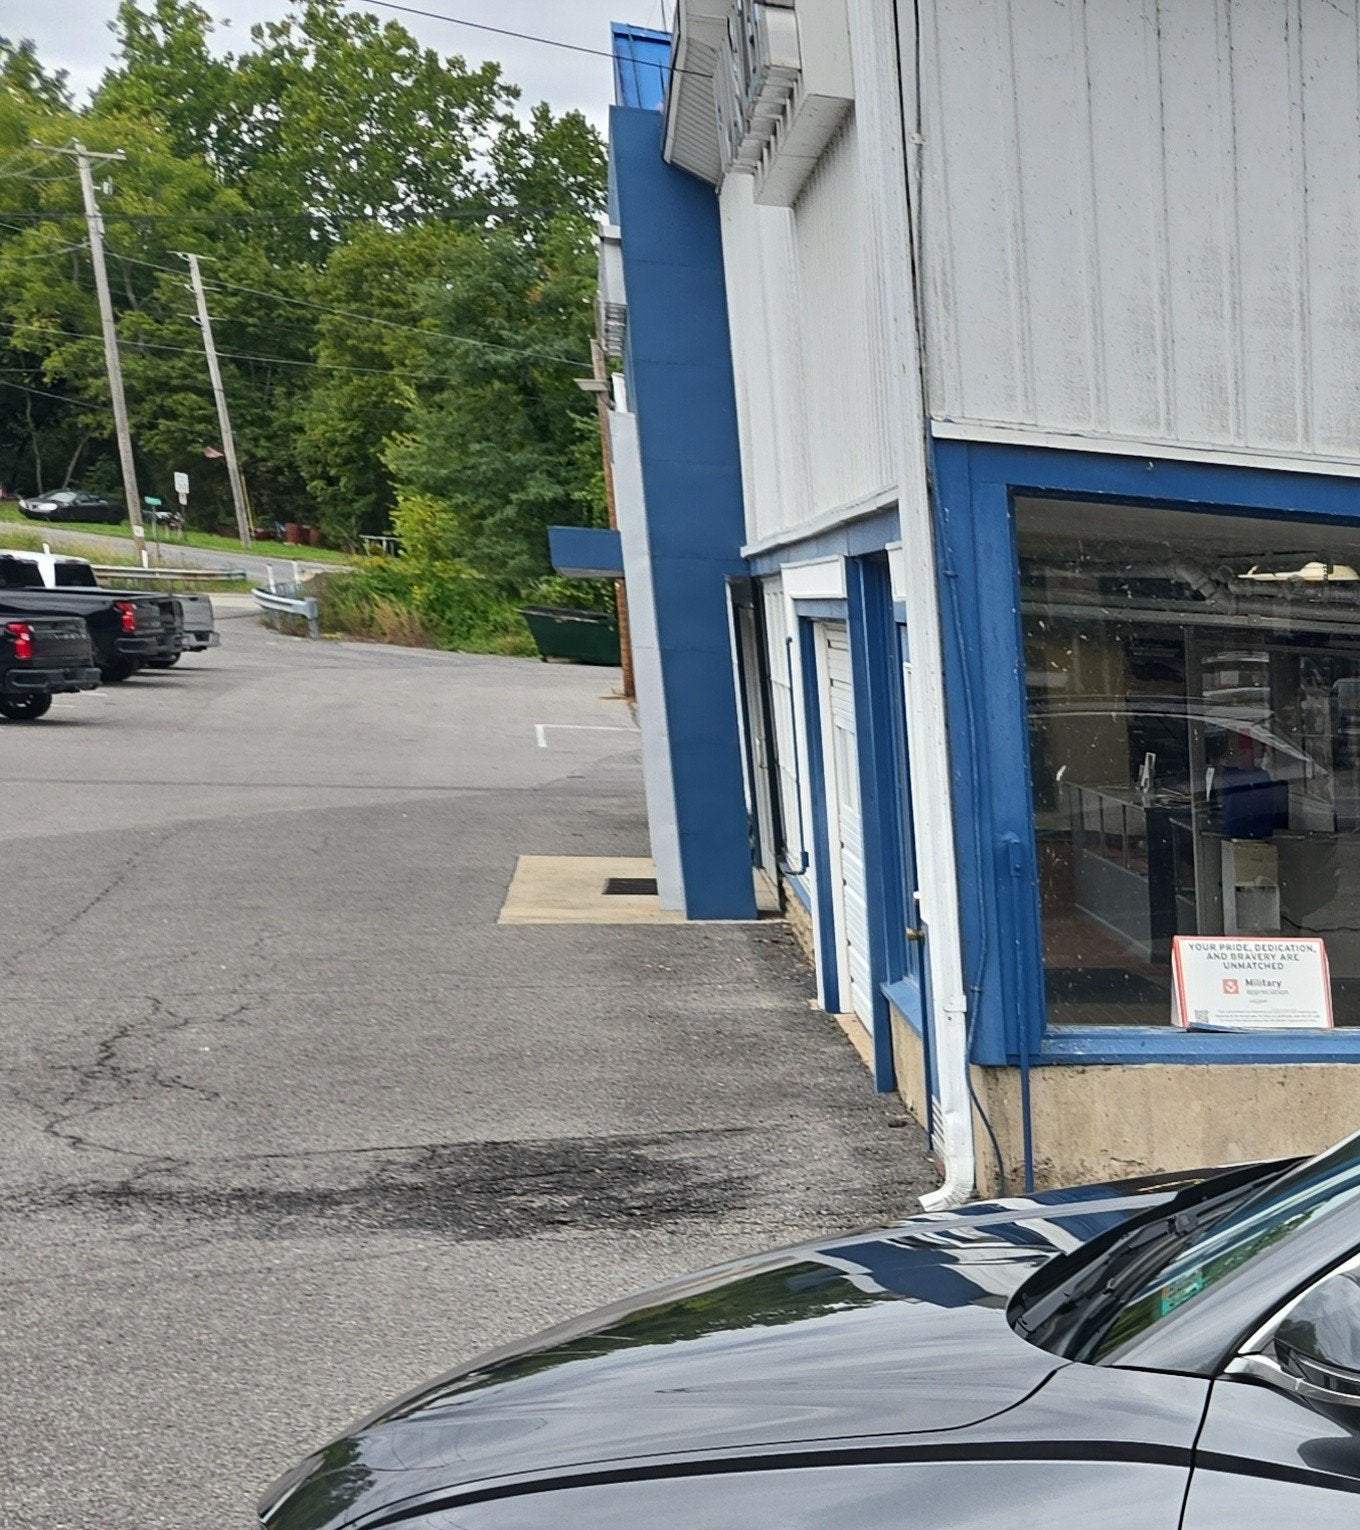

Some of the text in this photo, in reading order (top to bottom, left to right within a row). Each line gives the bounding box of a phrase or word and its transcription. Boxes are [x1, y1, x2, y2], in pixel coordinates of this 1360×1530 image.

[1188, 943, 1317, 953] YOUR PRIDE, DEDICATION,
[1230, 953, 1276, 961] BRAVERY
[1223, 962, 1285, 970] UNMATCHED
[1245, 979, 1282, 989] Military
[1246, 988, 1289, 996] appreciation
